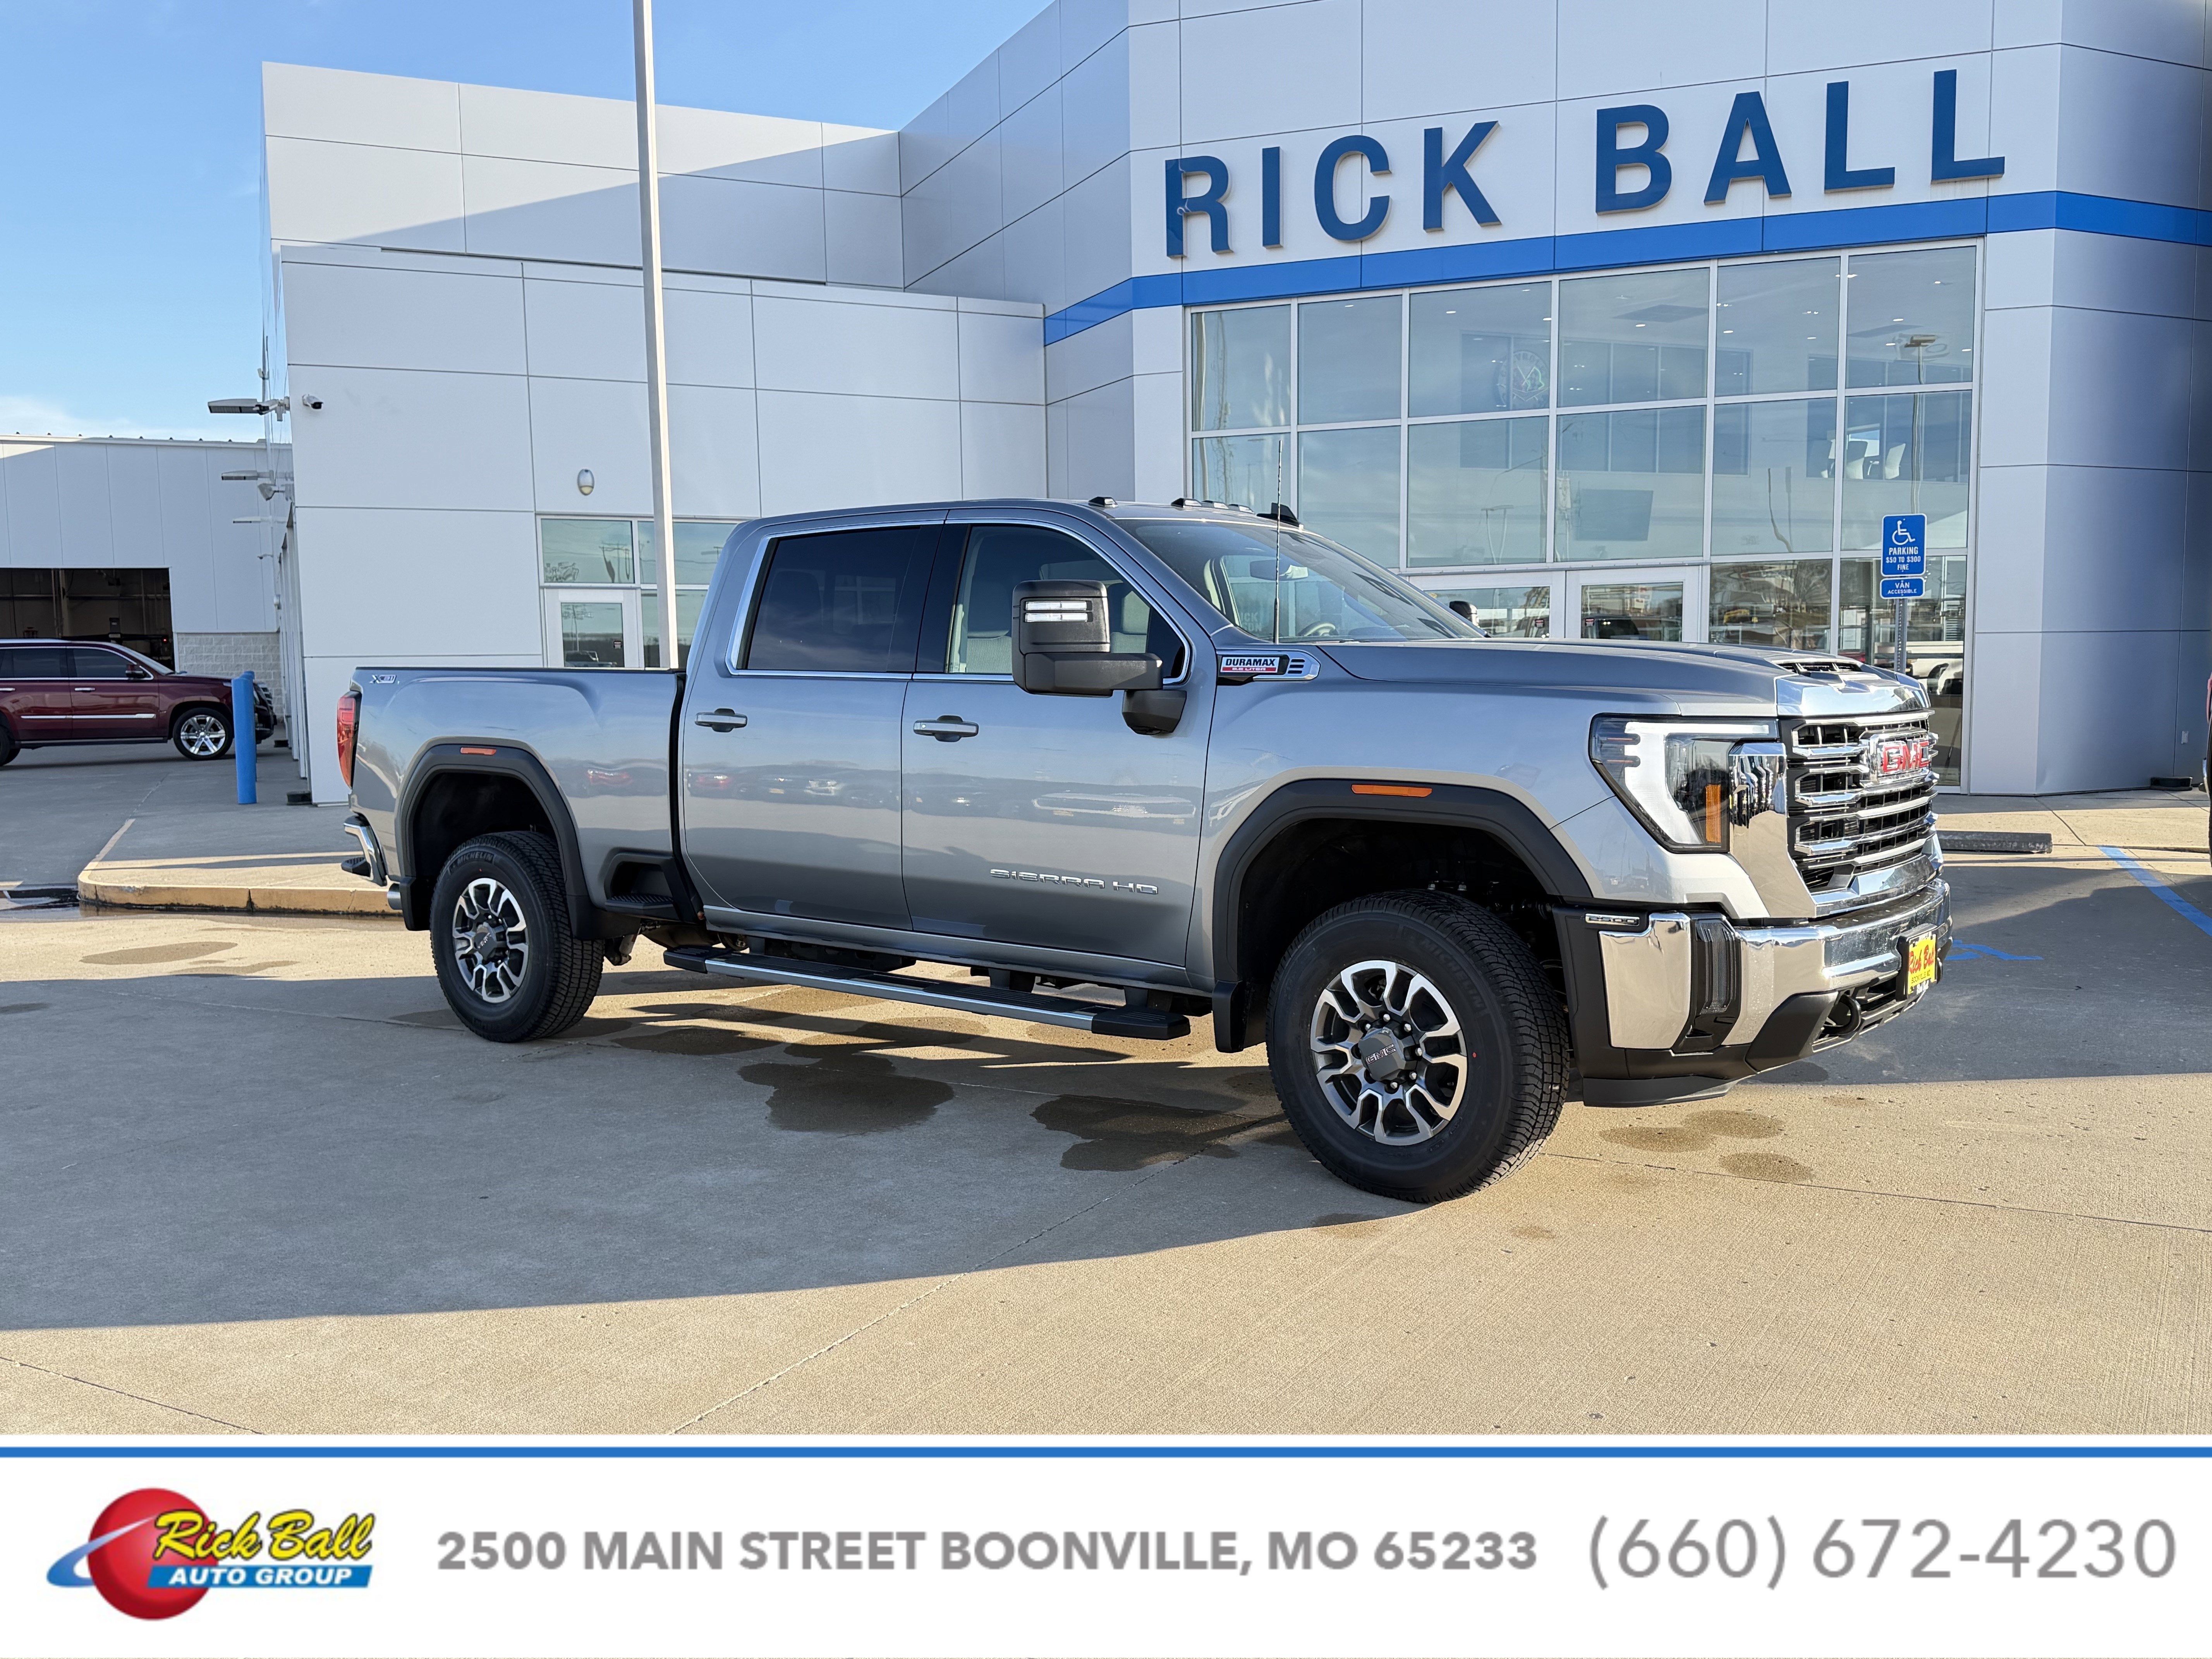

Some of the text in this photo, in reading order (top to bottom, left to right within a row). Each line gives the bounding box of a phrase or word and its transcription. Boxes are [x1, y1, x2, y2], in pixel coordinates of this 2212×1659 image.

[1164, 69, 2007, 259] RICK BALL
[1889, 546, 1918, 555] PARKING
[1882, 740, 1929, 773] GMC
[990, 868, 1159, 895] SIERRA HD
[1365, 1044, 1396, 1065] GMC
